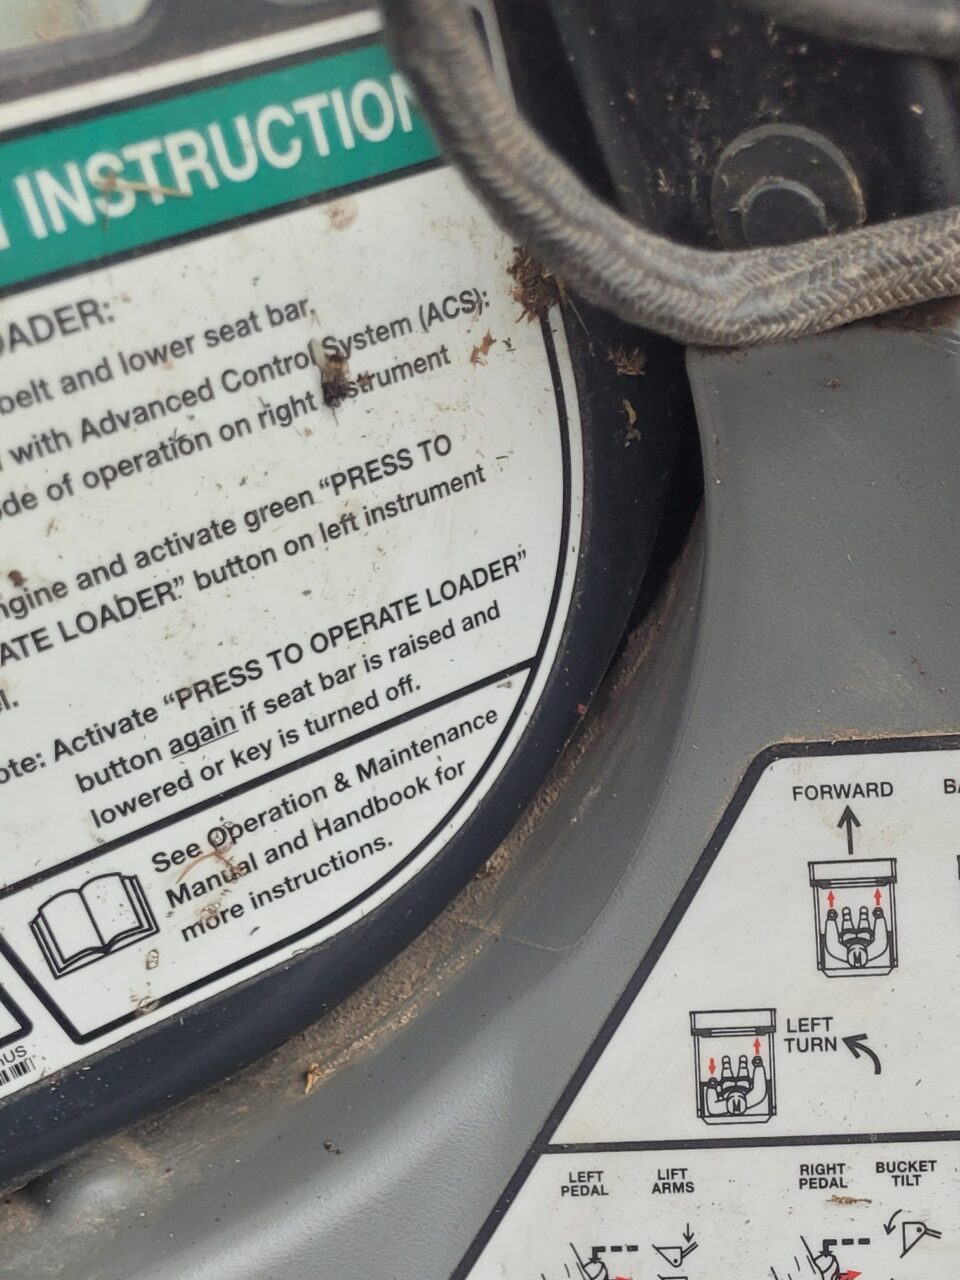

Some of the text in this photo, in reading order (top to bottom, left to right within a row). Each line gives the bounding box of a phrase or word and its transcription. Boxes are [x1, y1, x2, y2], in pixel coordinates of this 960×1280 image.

[0, 298, 114, 356] ADER:
[59, 356, 114, 395] and
[117, 335, 194, 375] lower
[203, 310, 262, 348] seat
[8, 428, 73, 464] with
[81, 376, 216, 444] Advanced
[220, 341, 318, 394] Control
[418, 287, 490, 333] (ACS):
[0, 490, 39, 520] de
[46, 472, 74, 502] of
[82, 429, 213, 490] operation
[218, 417, 253, 442] on
[257, 390, 319, 430] right
[75, 552, 128, 591] and
[133, 518, 237, 570] activate
[243, 489, 316, 534] green
[416, 433, 452, 463] TO
[0, 626, 54, 668] ATE
[192, 547, 278, 592] button
[283, 533, 315, 557] on
[318, 502, 361, 544] left
[362, 463, 487, 527] instrument
[53, 706, 159, 763] Activate
[265, 642, 304, 671] TO
[309, 592, 422, 654] OPERATE
[74, 599, 501, 794] button again if seat bar is raised and
[89, 673, 421, 829] lowered or key is turned off.
[151, 709, 498, 873] See Operation & Maintenance
[793, 782, 893, 801] FORWARD
[164, 757, 466, 909] Manual and Handbook for
[180, 836, 393, 943] more instructions.
[784, 1037, 837, 1053] TURN
[787, 1017, 833, 1033] LEFT
[561, 1185, 609, 1197] PEDAL
[569, 1171, 603, 1183] LEFT
[652, 1181, 694, 1194] ARMS
[658, 1168, 688, 1180] LIFT
[799, 1177, 848, 1189] PEDAL
[800, 1163, 846, 1176] RIGHT
[876, 1160, 937, 1174] BUCKET
[891, 1174, 922, 1186] TILT
